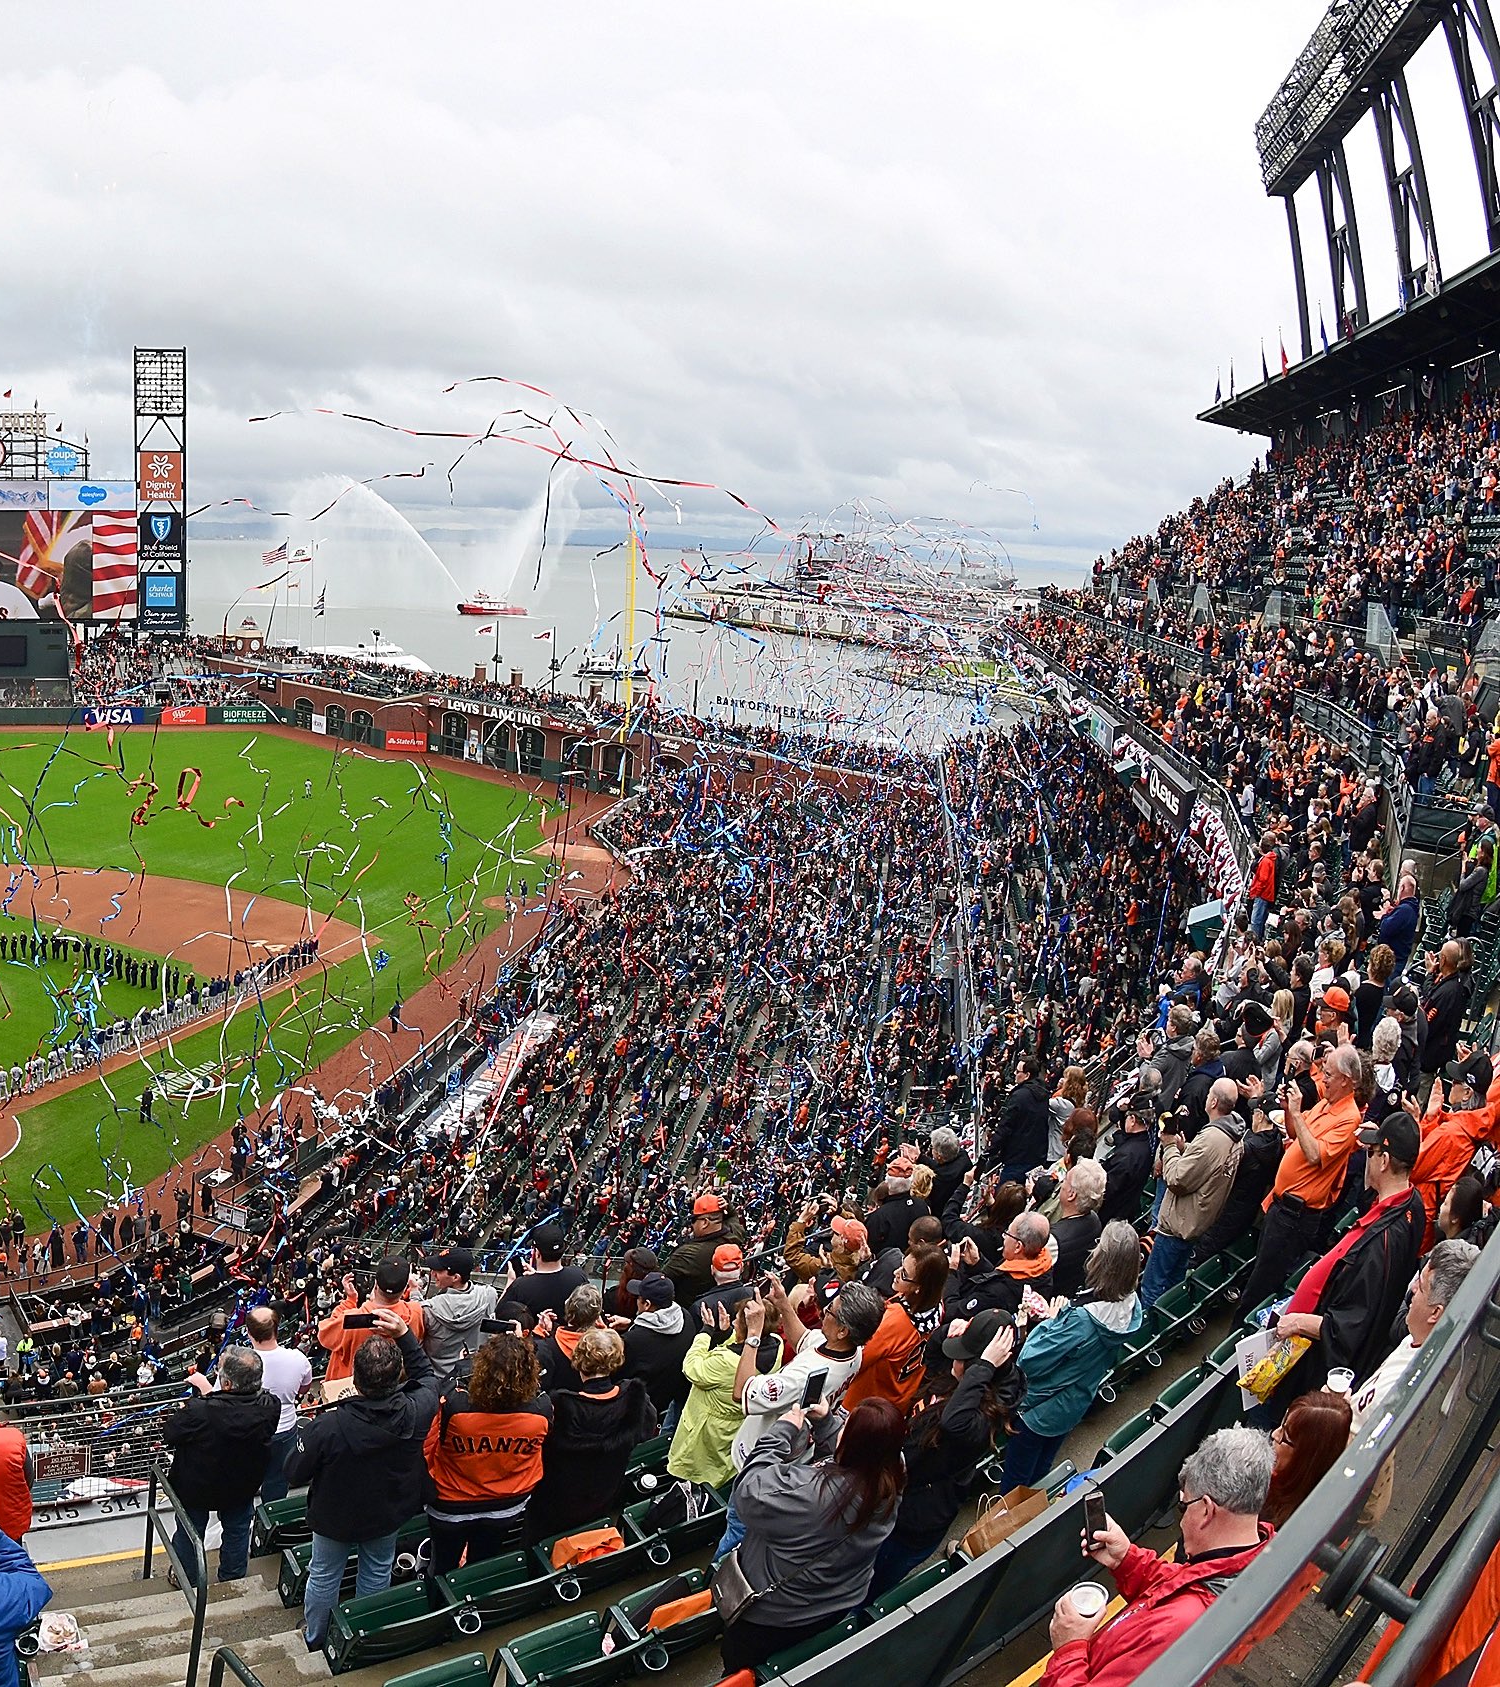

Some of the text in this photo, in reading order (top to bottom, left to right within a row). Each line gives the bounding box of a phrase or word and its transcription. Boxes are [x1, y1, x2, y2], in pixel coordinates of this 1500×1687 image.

[1, 413, 48, 437] PARK
[49, 451, 76, 460] coupa
[145, 480, 176, 490] Dignity
[148, 584, 173, 592] charles
[93, 709, 133, 724] VISA
[223, 710, 266, 718] BIOFREEZE
[483, 705, 542, 727] LANDING
[609, 786, 621, 796] 309
[1157, 780, 1180, 816] LEXUS
[452, 1436, 541, 1455] GIANTS
[45, 1449, 80, 1458] PLEASE
[98, 1496, 141, 1515] 314
[38, 1507, 80, 1523] 315
